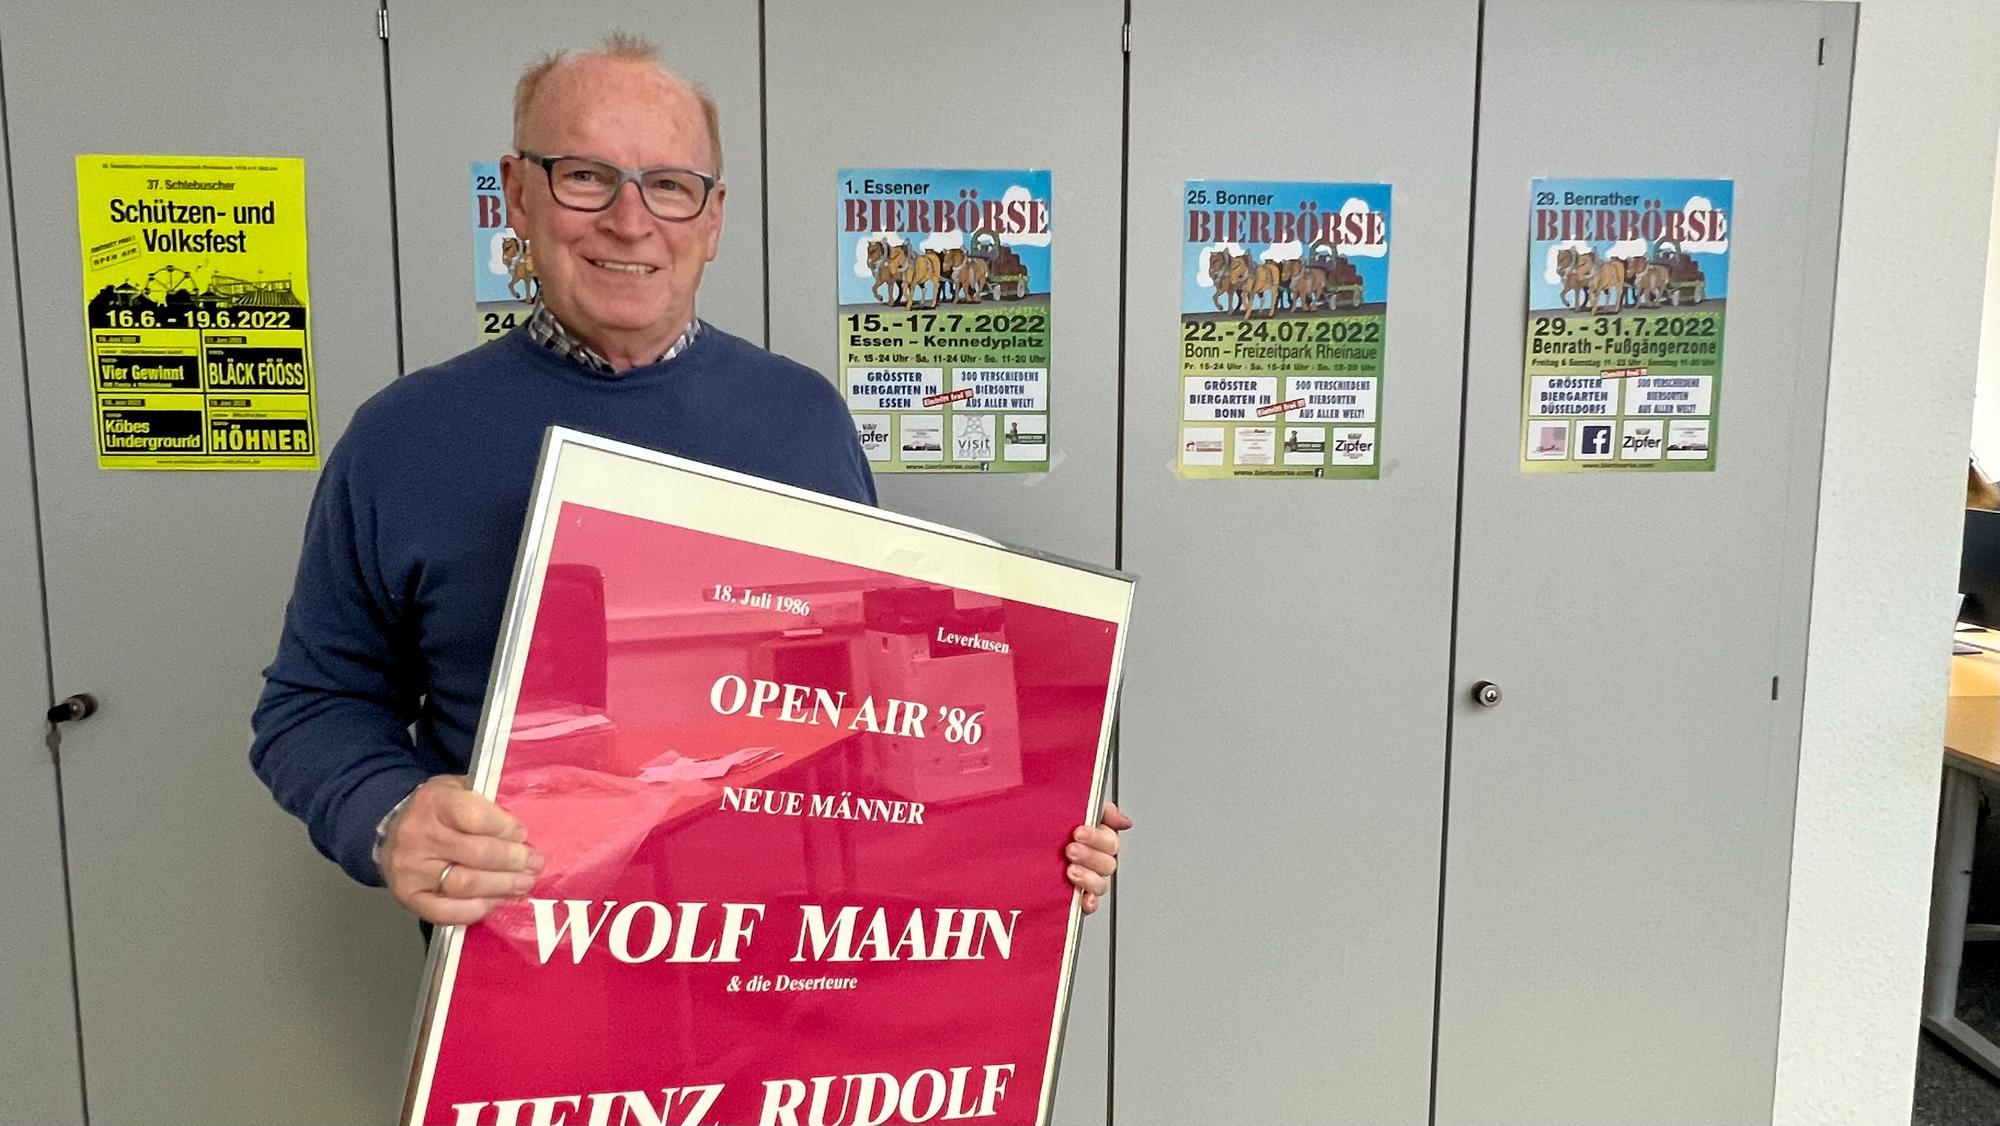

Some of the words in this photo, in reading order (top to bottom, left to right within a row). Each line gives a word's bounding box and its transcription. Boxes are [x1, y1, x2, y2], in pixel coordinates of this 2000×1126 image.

[147, 179, 163, 190] 37.
[165, 180, 235, 191] Schlebuscher
[477, 176, 501, 190] 22.
[846, 180, 858, 194] 1.
[864, 180, 930, 195] Essener
[1187, 190, 1210, 204] 25.
[1216, 190, 1274, 205] Bonner
[1536, 192, 1559, 206] 29.
[1564, 192, 1640, 206] Benrather
[110, 199, 226, 224] Schützen-
[234, 201, 275, 224] und
[845, 189, 1048, 234] BIERBÖRSE
[1188, 201, 1384, 245] BIERBÖRSE
[1536, 199, 1727, 242] BIERBÖRSE
[143, 228, 247, 253] Volksfest
[106, 311, 162, 327] 16.6.
[184, 311, 291, 328] 19.6.2022
[850, 336, 903, 347] Essen
[924, 336, 1044, 350] Kennedyplatz
[1533, 338, 1591, 354] Benrath
[1605, 339, 1716, 358] Fußgängerzone
[892, 354, 909, 362] Uhr
[1185, 343, 1219, 358] Bonn
[1234, 343, 1311, 362] Freizeitpark
[1316, 344, 1377, 359] Rheinaue
[102, 365, 128, 380] Vier
[132, 365, 184, 380] Gewinnt
[209, 358, 255, 385] BLÄCK
[258, 358, 303, 385] FÖÖSS
[867, 369, 922, 382] GRÖSSTER
[980, 371, 1039, 382] VERSCHIEDENE
[852, 385, 920, 395] BIERGARTEN
[925, 385, 937, 395] IN
[975, 385, 1025, 395] BIERSORTEN
[1204, 378, 1258, 391] GRÖSSTER
[1314, 381, 1370, 391] VERSCHIEDENE
[1548, 377, 1603, 389] GRÖSSTER
[879, 398, 911, 408] ESSEN
[966, 398, 981, 408] AUS
[984, 398, 1008, 408] ALLER
[1010, 398, 1034, 408] WELT!
[1189, 394, 1256, 405] BIERGARTEN
[1259, 395, 1271, 405] IN
[1308, 395, 1356, 405] BIERSORTEN
[1540, 391, 1608, 402] BIERGARTEN
[1215, 409, 1245, 418] BONN
[1299, 409, 1314, 419] AUS
[1317, 409, 1340, 419] ALLER
[1541, 402, 1606, 414] DÜSSELDORFS
[105, 419, 150, 433] Köbes
[106, 434, 201, 451] Underground
[213, 424, 308, 451] HÖHNER
[858, 430, 889, 444] ipfer
[958, 438, 991, 449] visit
[1622, 435, 1662, 453] Zipfer
[1335, 439, 1373, 453] Zipfer
[712, 584, 737, 603] 18.
[741, 589, 773, 610] Juli
[776, 595, 811, 617] 1986
[936, 627, 1010, 654] Leverkusen
[710, 674, 847, 728] OPEN
[848, 695, 929, 739] AIR
[938, 705, 985, 745] '86
[719, 786, 805, 816] NEUE
[808, 791, 926, 825] MÄNNER
[528, 898, 765, 965] WOLF
[791, 904, 1024, 962] MAAHN
[726, 975, 743, 992] &
[746, 974, 771, 992] die
[775, 974, 858, 992] Deserteure
[757, 1063, 1016, 1126] RUDOLF
